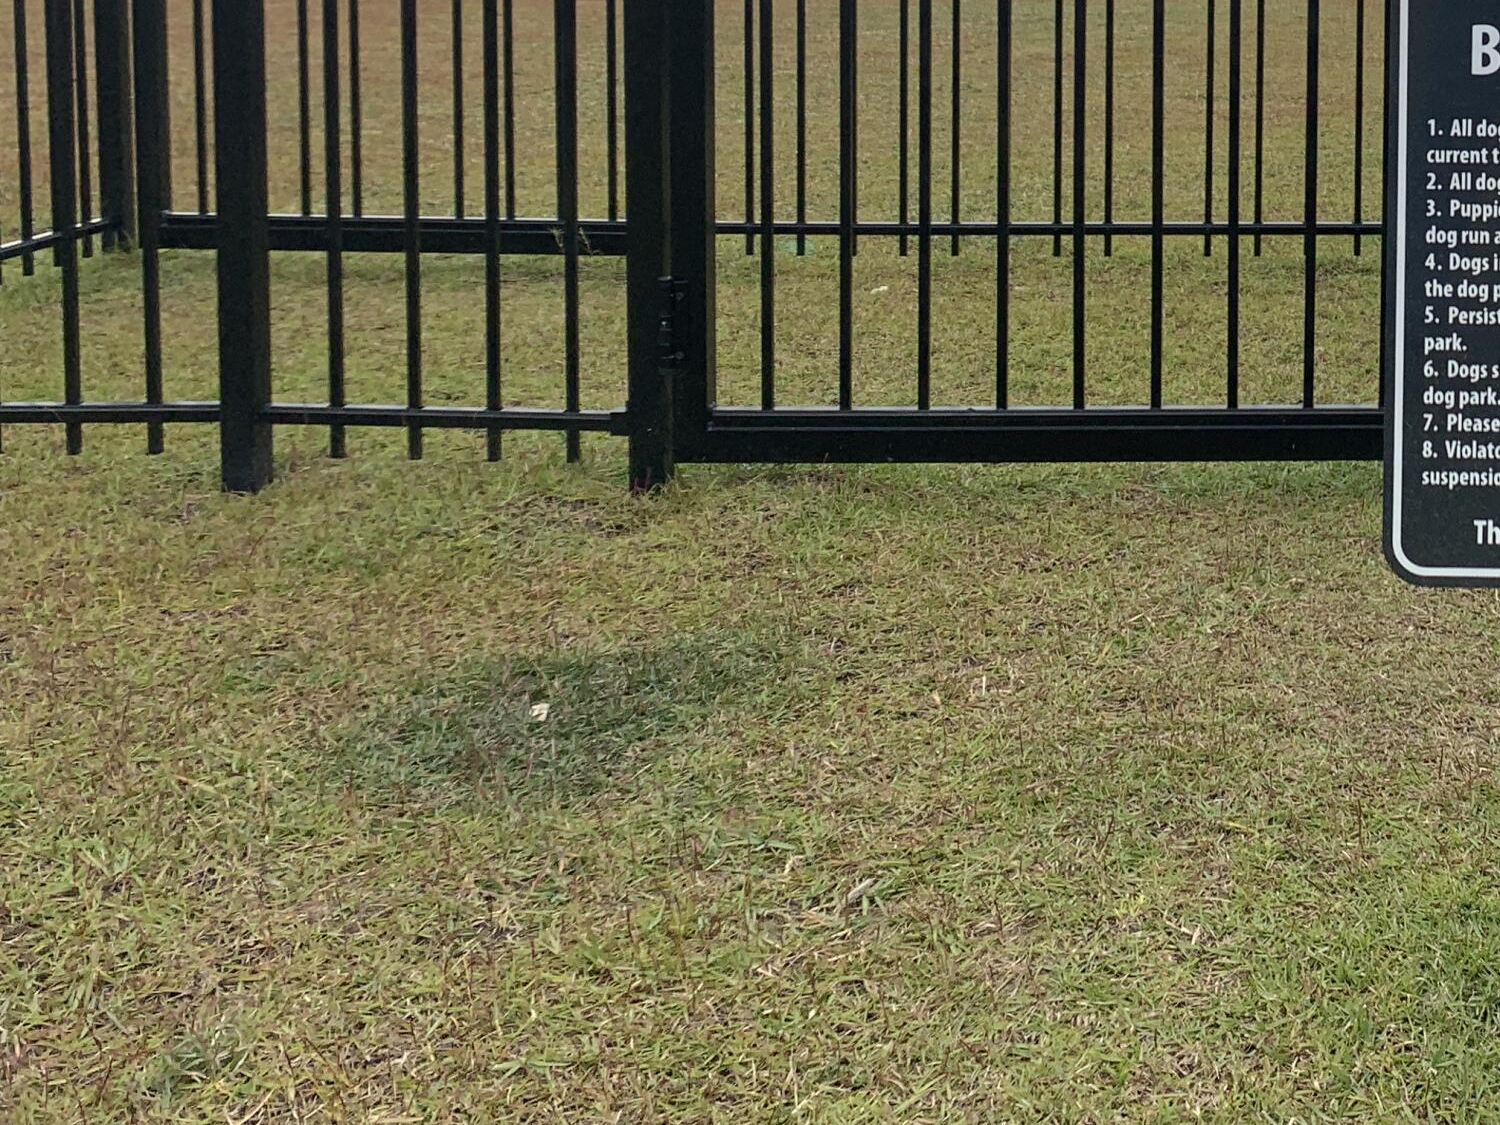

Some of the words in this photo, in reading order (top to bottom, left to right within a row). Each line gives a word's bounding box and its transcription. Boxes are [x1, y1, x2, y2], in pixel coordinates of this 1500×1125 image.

[1427, 118, 1444, 137] 1.
[1450, 118, 1473, 137] All
[1426, 147, 1489, 164] current
[1426, 172, 1443, 190] 2.
[1449, 171, 1472, 191] All
[1425, 199, 1442, 217] 3.
[1425, 224, 1458, 249] dog
[1461, 230, 1490, 245] run
[1424, 252, 1443, 271] 4.
[1449, 252, 1490, 276] Dogs
[1424, 278, 1454, 298] the
[1457, 278, 1489, 303] dog
[1424, 305, 1440, 324] 5.
[1424, 332, 1468, 356] park.
[1423, 359, 1439, 378] 6.
[1447, 359, 1488, 383] Dogs
[1423, 385, 1455, 410] dog
[1423, 413, 1439, 432] 7.
[1446, 412, 1500, 433] Please
[1421, 440, 1438, 459] 8.
